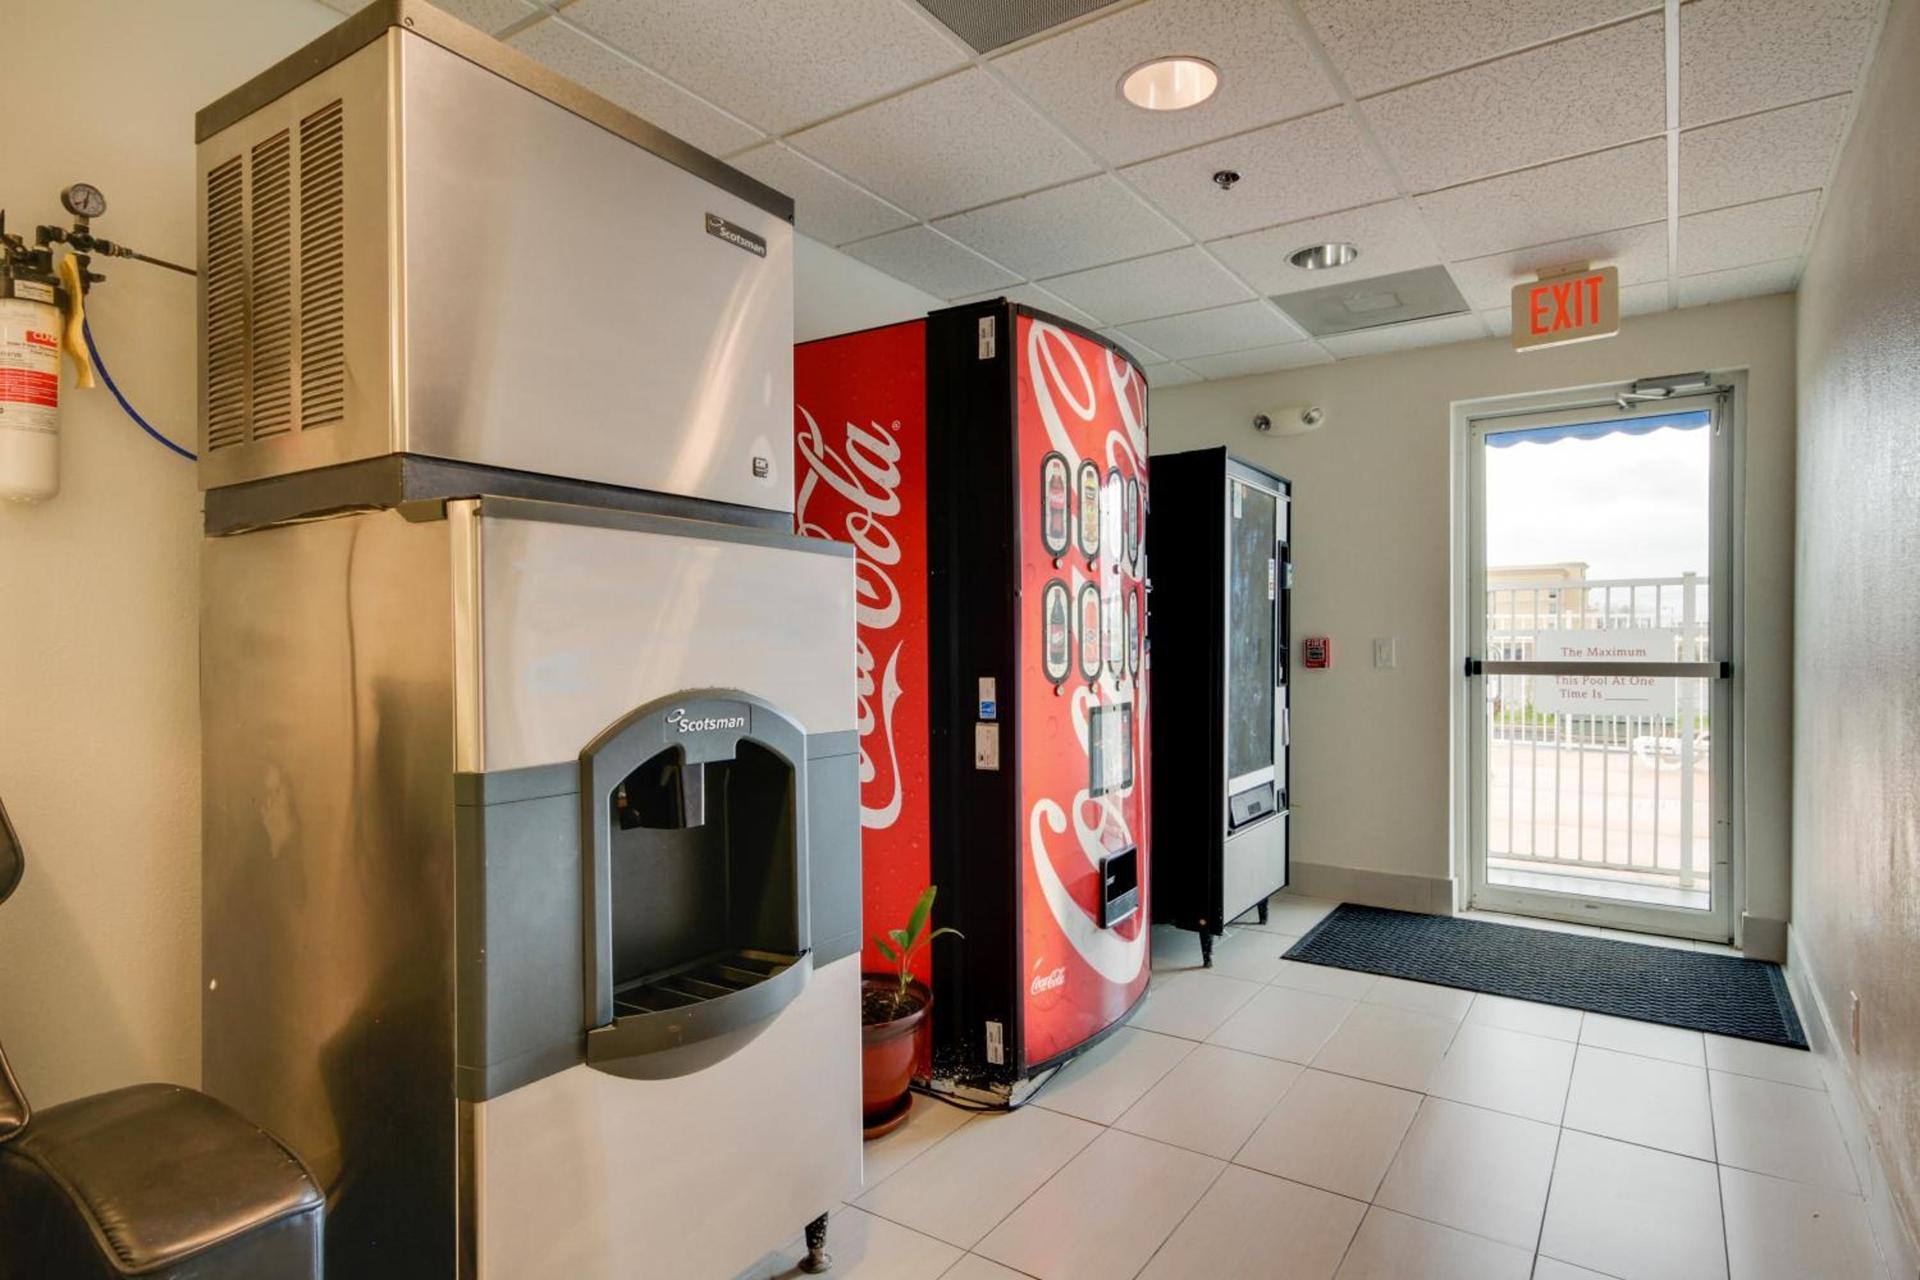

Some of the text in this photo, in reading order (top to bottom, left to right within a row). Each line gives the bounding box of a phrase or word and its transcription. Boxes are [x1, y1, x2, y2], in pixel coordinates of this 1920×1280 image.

[720, 226, 764, 255] Scotsman
[1530, 275, 1603, 335] EXIT
[1561, 647, 1647, 657] The Maximum
[1555, 674, 1655, 686] This Pool At One
[1560, 688, 1602, 698] Time Is
[679, 717, 744, 732] Scotsman
